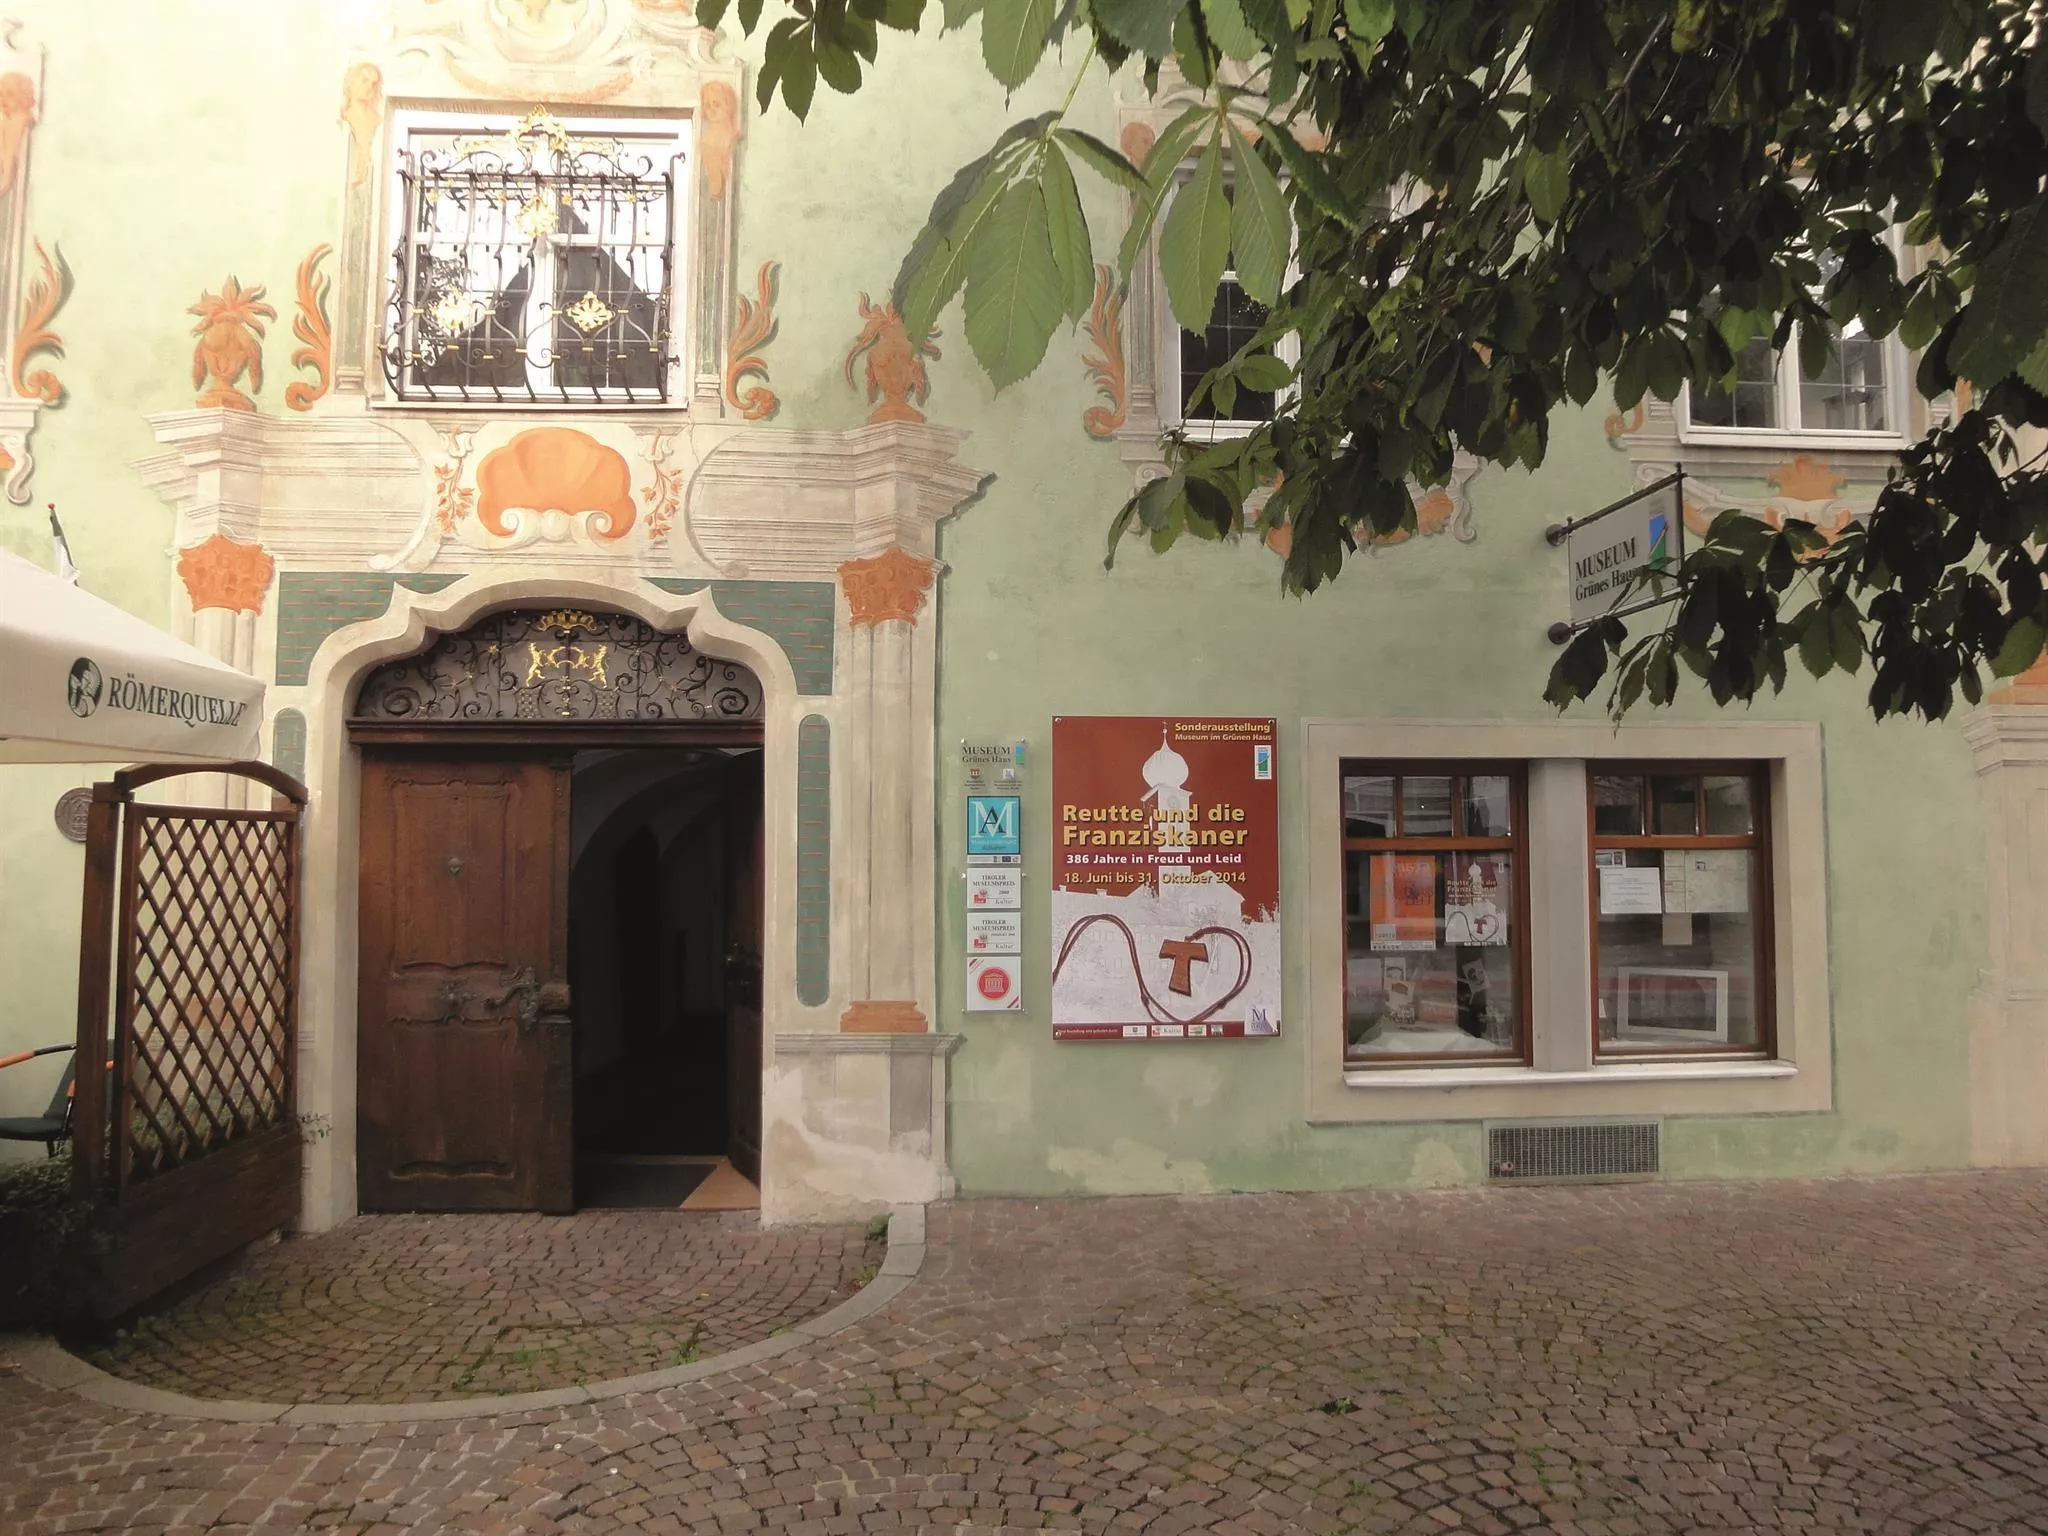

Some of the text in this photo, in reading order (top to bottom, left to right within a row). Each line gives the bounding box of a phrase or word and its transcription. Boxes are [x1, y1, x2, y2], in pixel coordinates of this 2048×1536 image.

[1575, 537, 1636, 580] MUSEUM
[1575, 579, 1610, 601] Grünes
[107, 673, 248, 728] RÖMERQUELLE
[1175, 722, 1271, 734] Sonderausstellung
[1175, 733, 1272, 741] Museum im Grünen Haus
[962, 746, 1010, 755] MUSEUM
[992, 755, 1011, 763] Haus
[1063, 804, 1246, 822] Reutte und die
[1063, 824, 1248, 847] Franziskaner
[1066, 853, 1242, 864] 386 Jahre in Freud und Leid
[1065, 871, 1247, 884] 18. Juni bis 31. Oktober 2014
